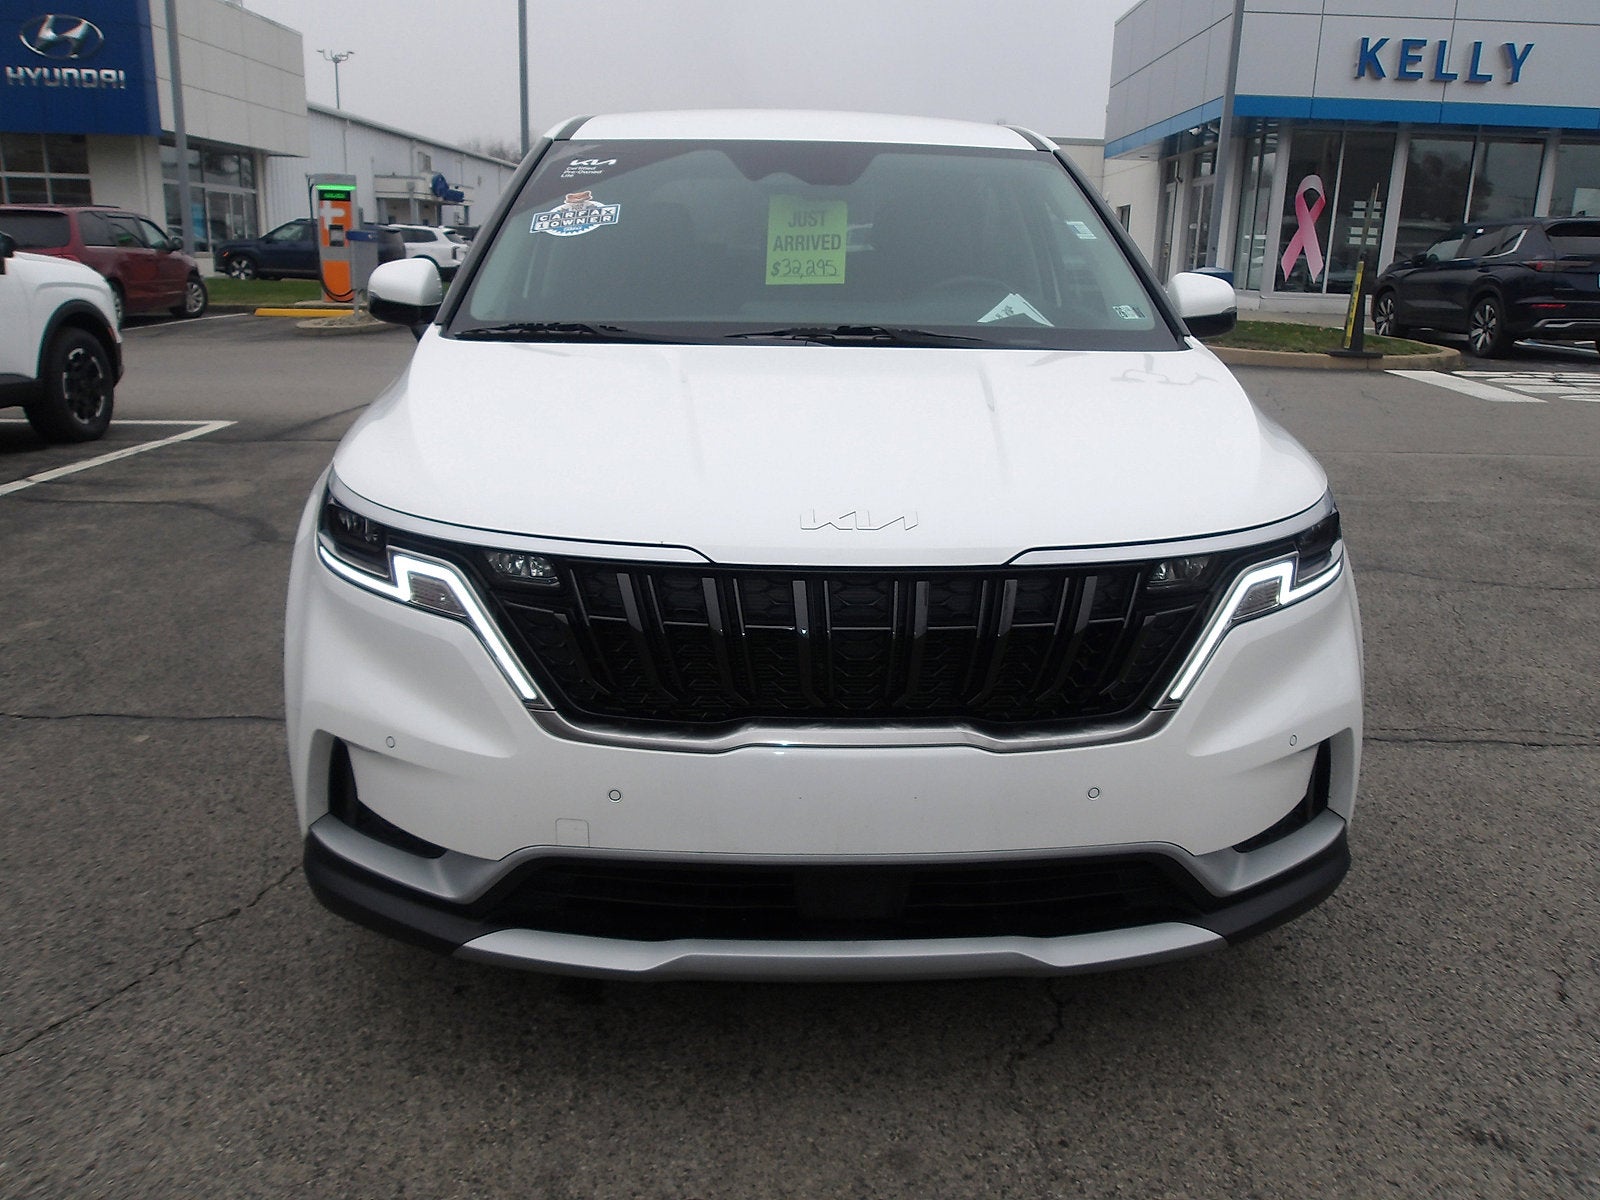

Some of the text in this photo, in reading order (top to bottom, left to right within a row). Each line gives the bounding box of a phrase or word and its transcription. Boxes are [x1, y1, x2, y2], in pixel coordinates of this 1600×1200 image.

[1355, 37, 1535, 84] KELLY
[5, 66, 126, 89] HYUNDAI
[538, 208, 616, 222] CARFAX
[787, 210, 826, 228] JUST
[772, 233, 842, 252] ARRIVED
[770, 258, 839, 279] $32,295
[799, 503, 919, 531] KIA
